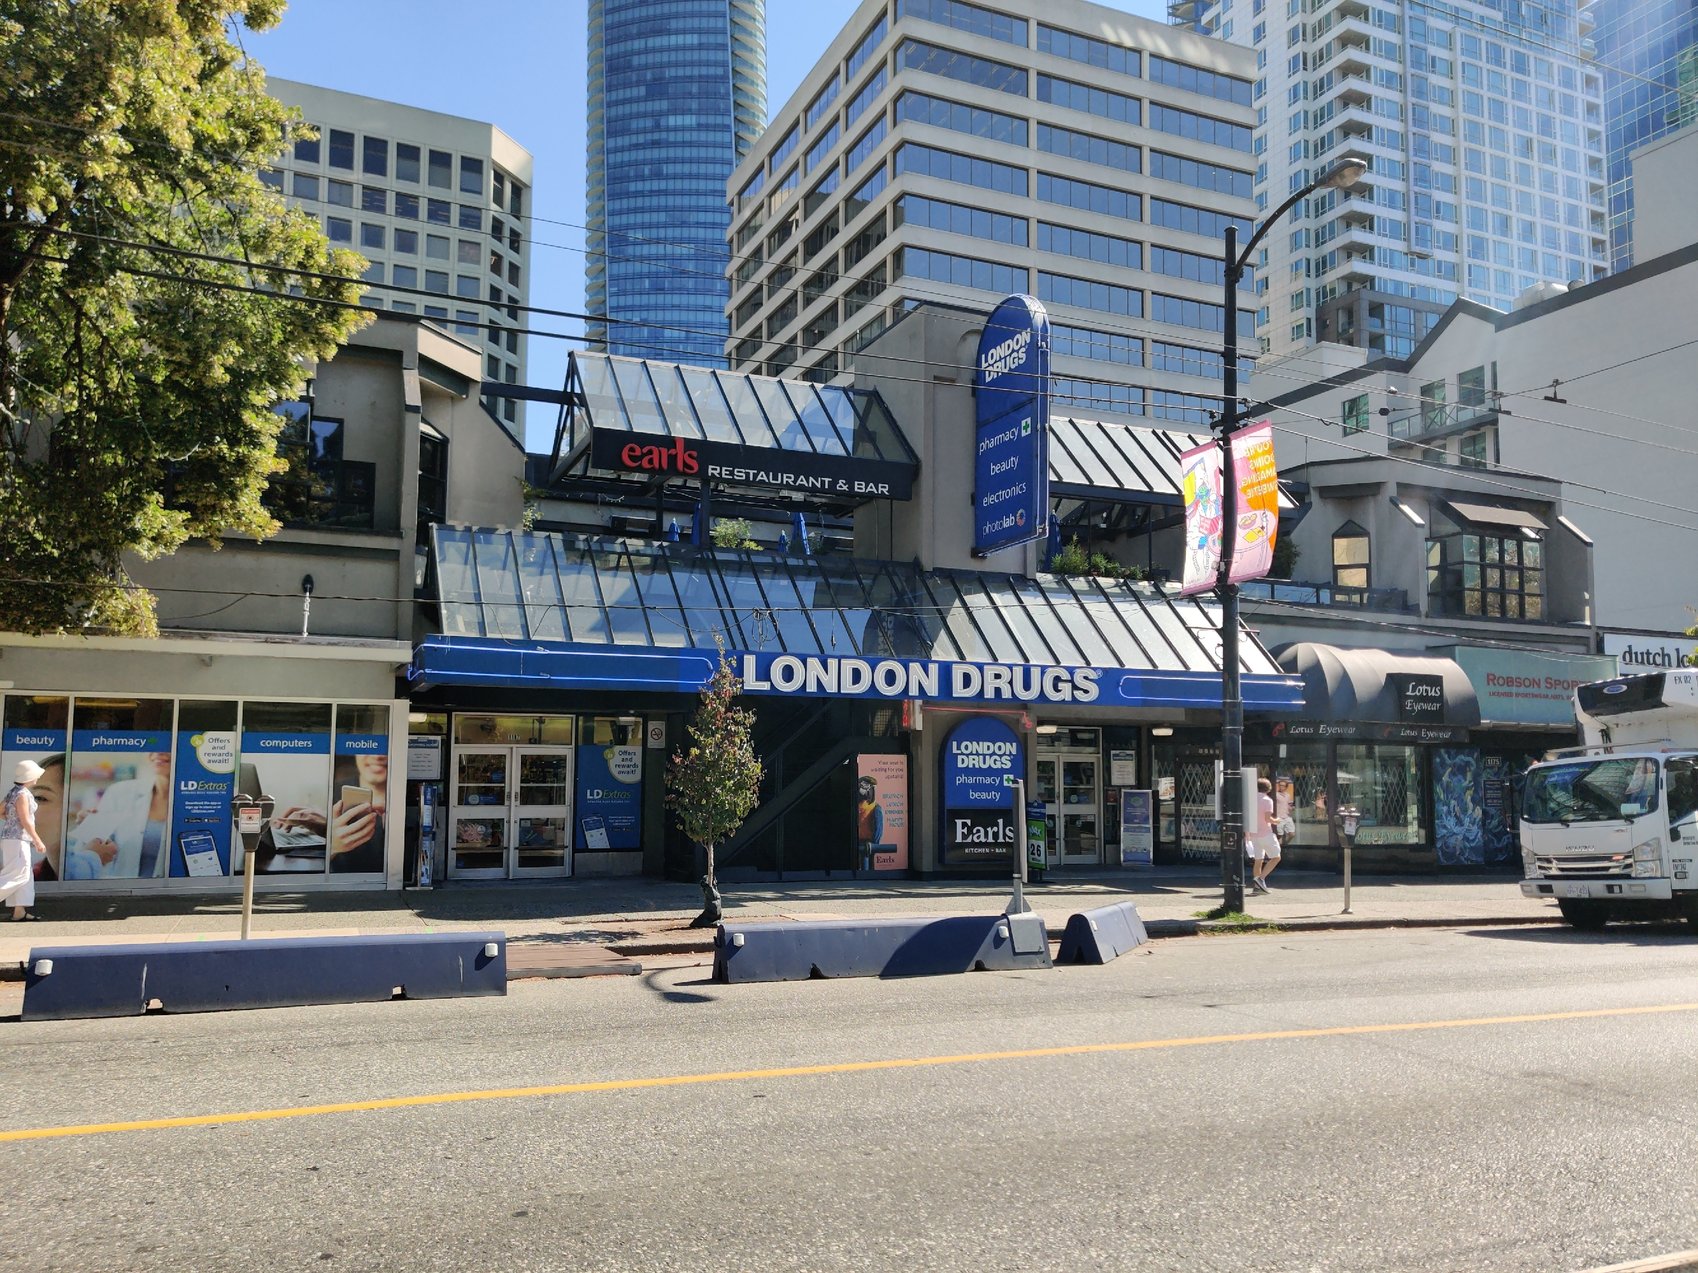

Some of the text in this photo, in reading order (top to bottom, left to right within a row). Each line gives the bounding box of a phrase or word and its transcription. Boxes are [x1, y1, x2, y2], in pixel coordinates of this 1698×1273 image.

[981, 328, 1031, 370] LONDON
[985, 347, 1027, 383] DRUGS
[979, 426, 1020, 455] pharmacy
[620, 437, 889, 495] earls RESTAURANT & BAR
[990, 455, 1019, 476] beauty
[983, 482, 1027, 507] electronics
[982, 513, 1015, 539] photolab
[1622, 644, 1672, 668] dutch
[743, 654, 939, 697] LONDON
[1486, 672, 1542, 689] ROBSON
[1406, 682, 1441, 697] Lotus
[1405, 700, 1441, 715] Eyewear
[1289, 724, 1356, 736] Lotus Eyewear
[1400, 728, 1452, 739] Lotus Eyewear
[16, 734, 55, 747] beauty
[92, 736, 147, 747] pharmacy
[260, 738, 313, 749] computers
[345, 740, 379, 749] mobile
[952, 741, 1017, 755] LONDON
[957, 755, 1012, 769] DRUGS
[956, 773, 1001, 786] pharmacy
[969, 790, 1001, 801] beauty
[954, 819, 1015, 843] Earls
[1030, 843, 1042, 858] 26
[876, 856, 895, 864] Earls
